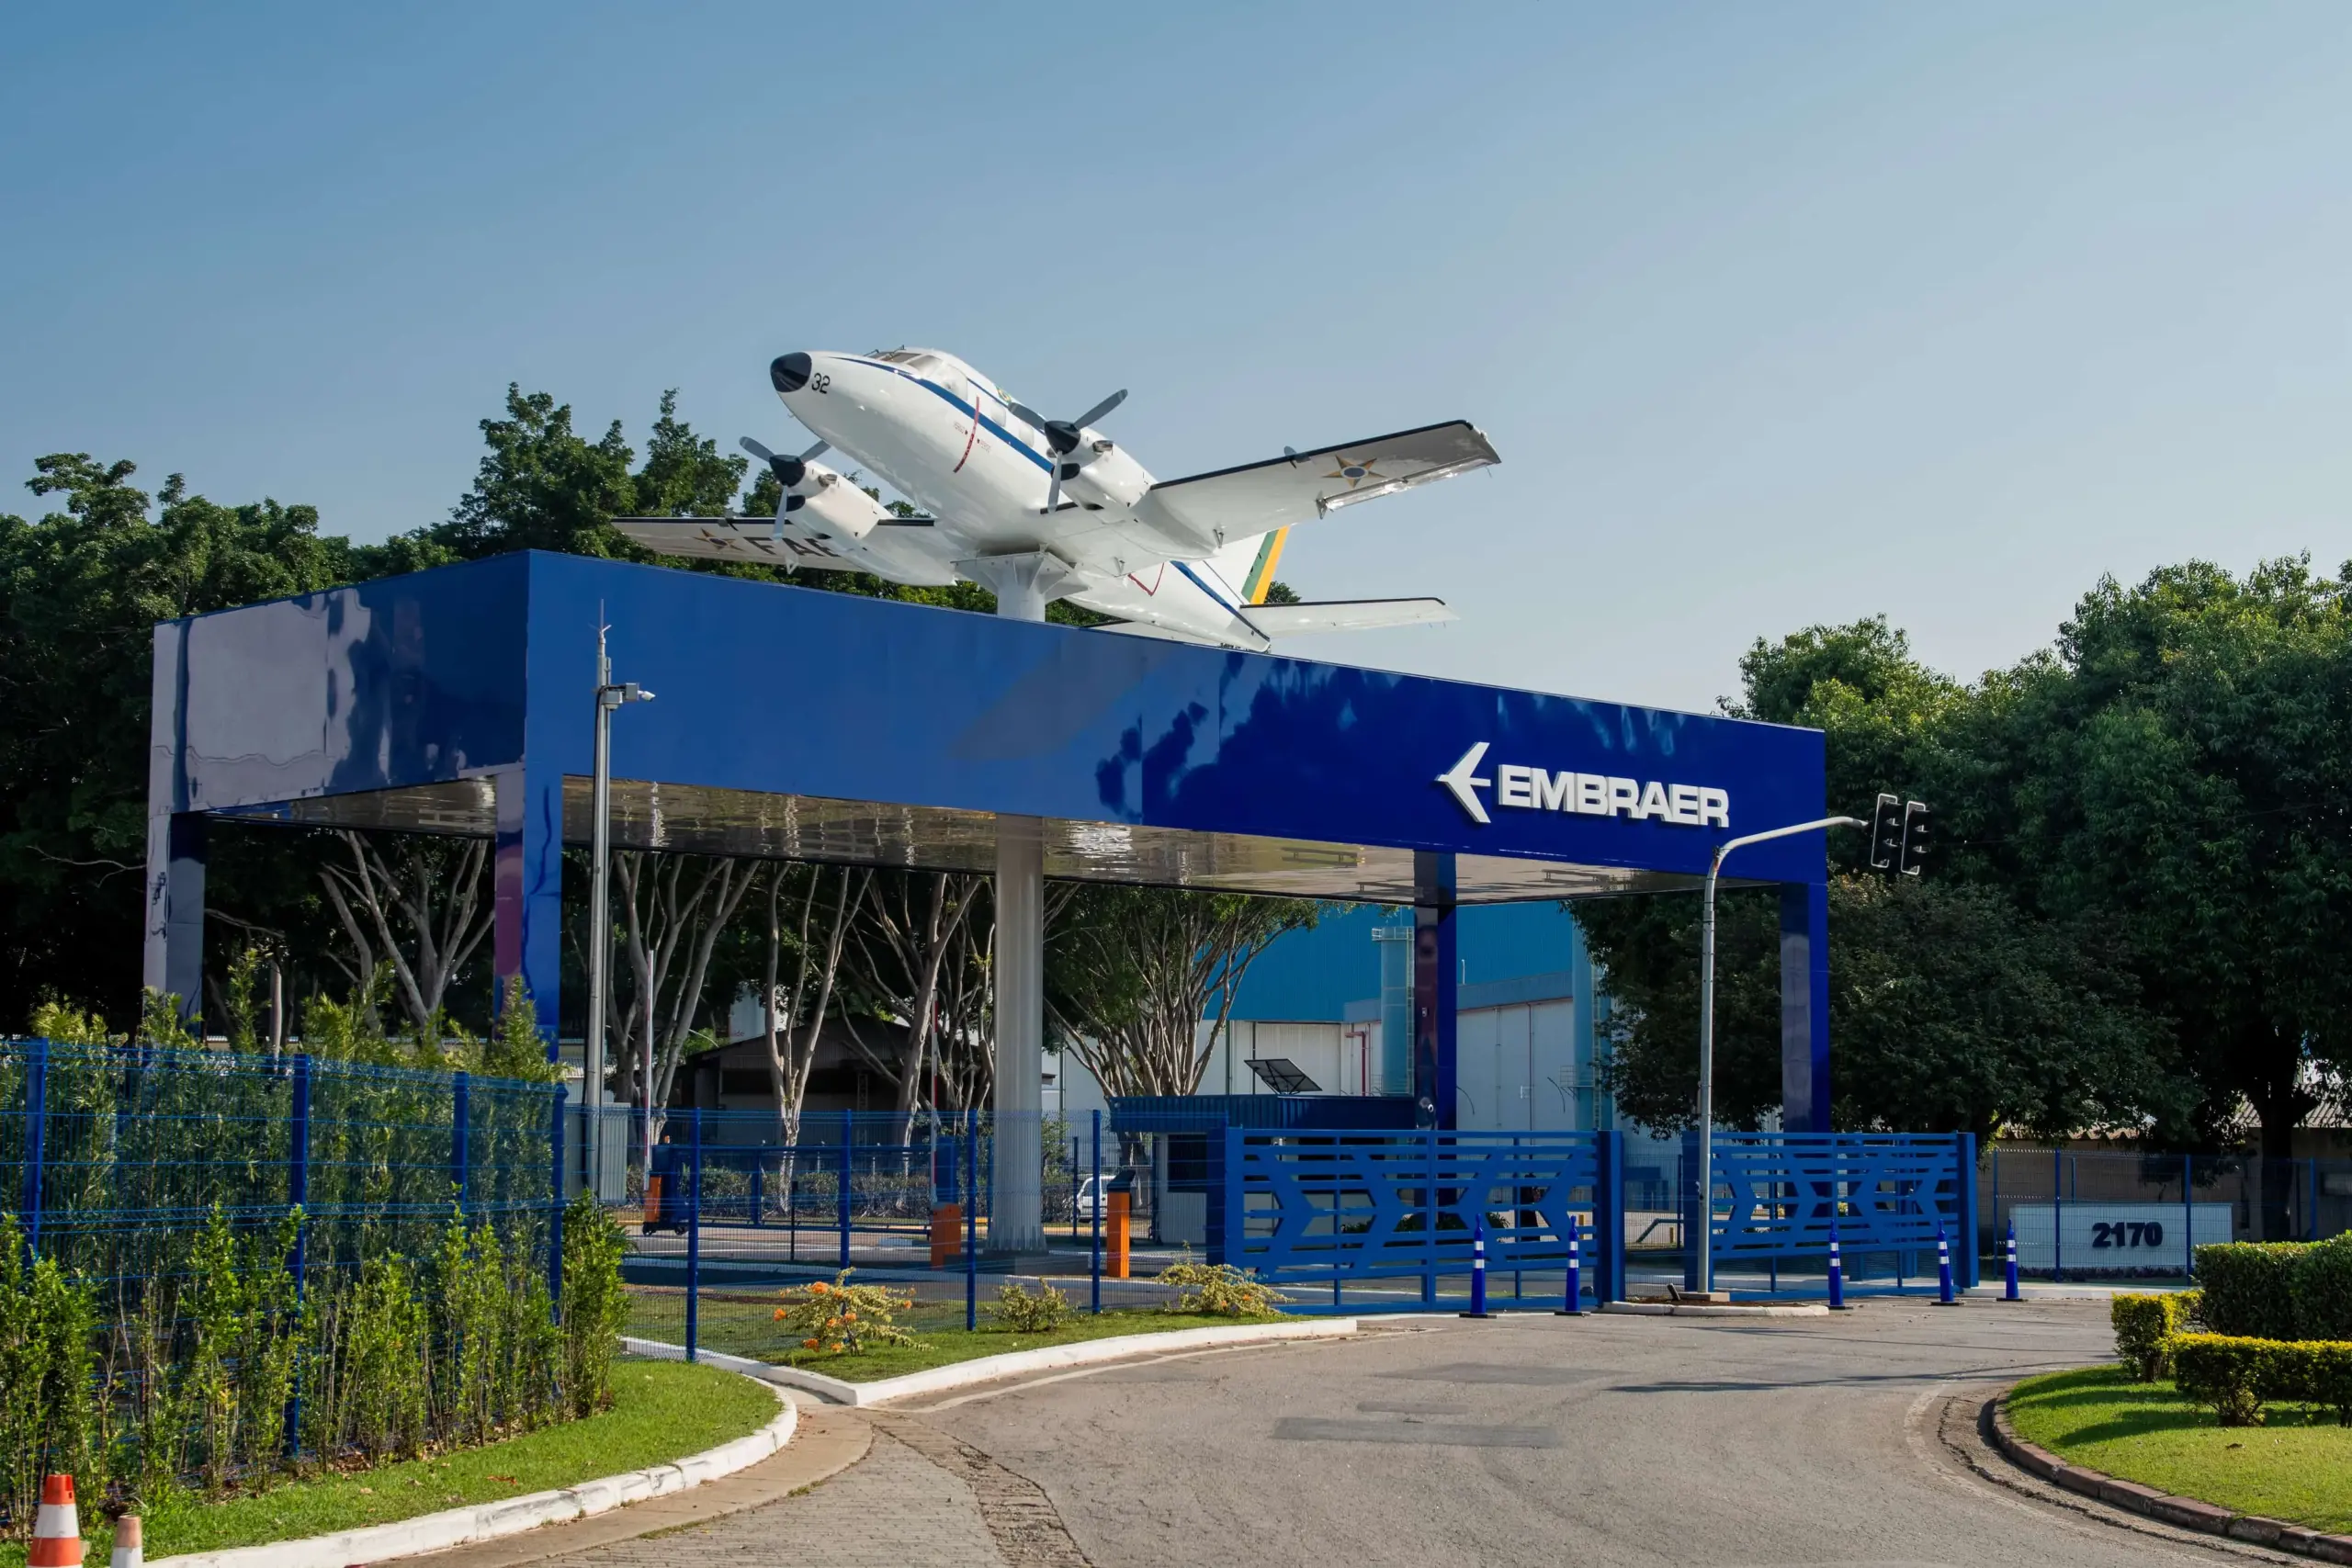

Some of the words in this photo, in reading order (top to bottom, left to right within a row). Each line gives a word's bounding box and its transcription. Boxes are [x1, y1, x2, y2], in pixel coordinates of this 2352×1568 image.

[811, 372, 831, 395] 32
[1498, 764, 1729, 828] EMBRAER
[2091, 1222, 2164, 1248] 2170
